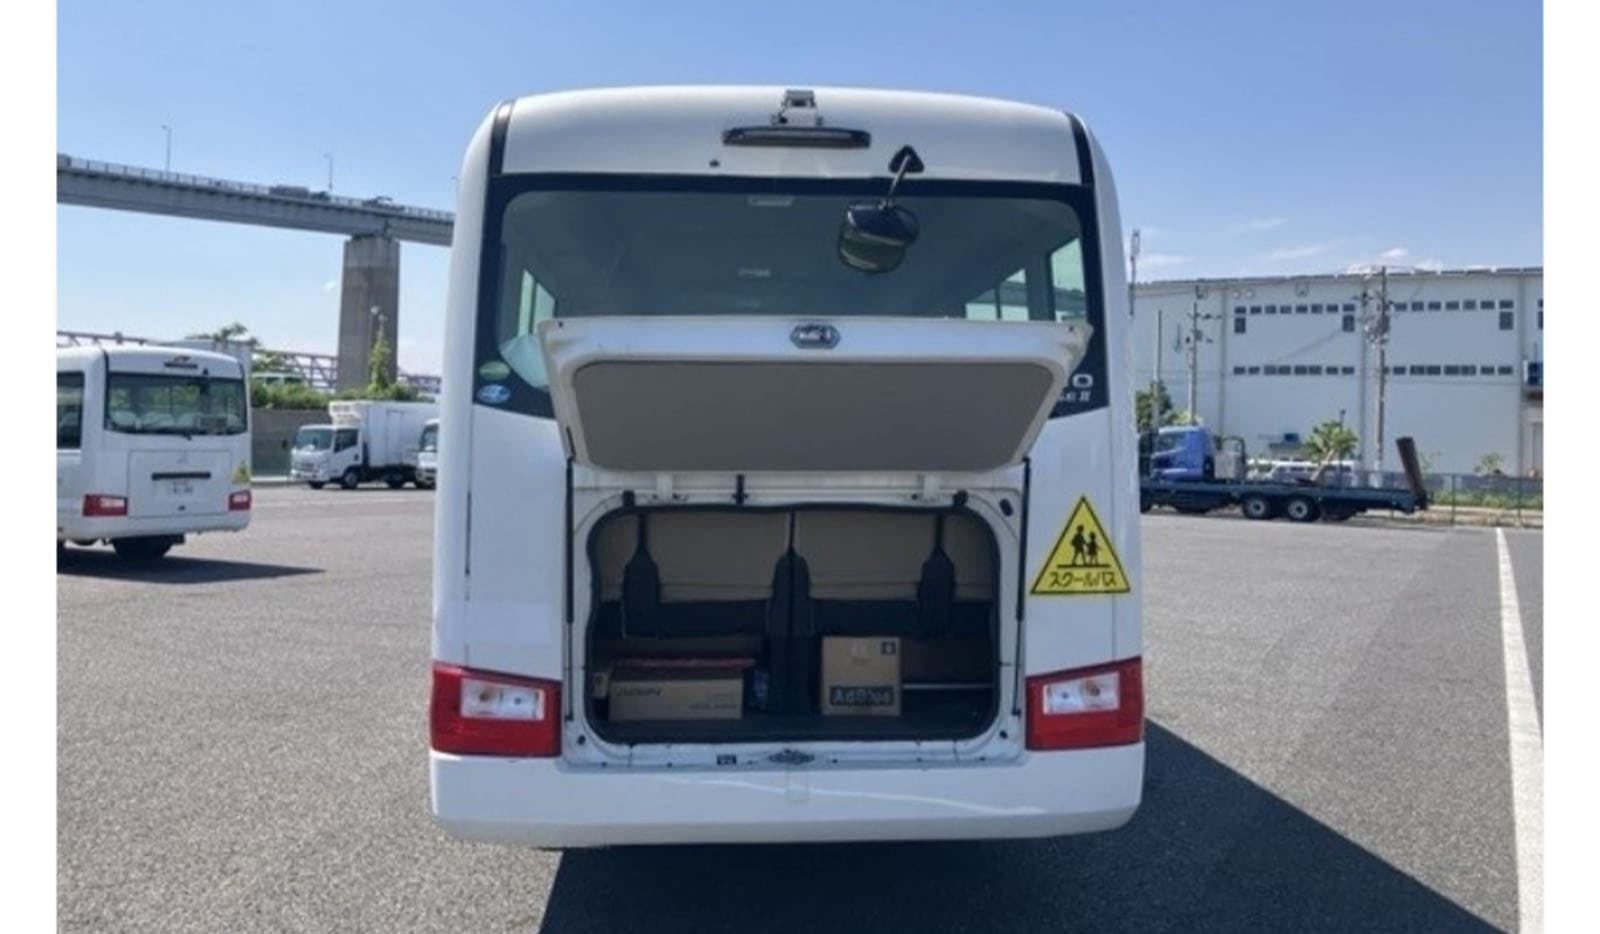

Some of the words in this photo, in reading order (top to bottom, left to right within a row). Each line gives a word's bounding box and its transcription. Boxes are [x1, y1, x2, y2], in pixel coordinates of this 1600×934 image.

[1049, 571, 1117, 588] スクールバス
